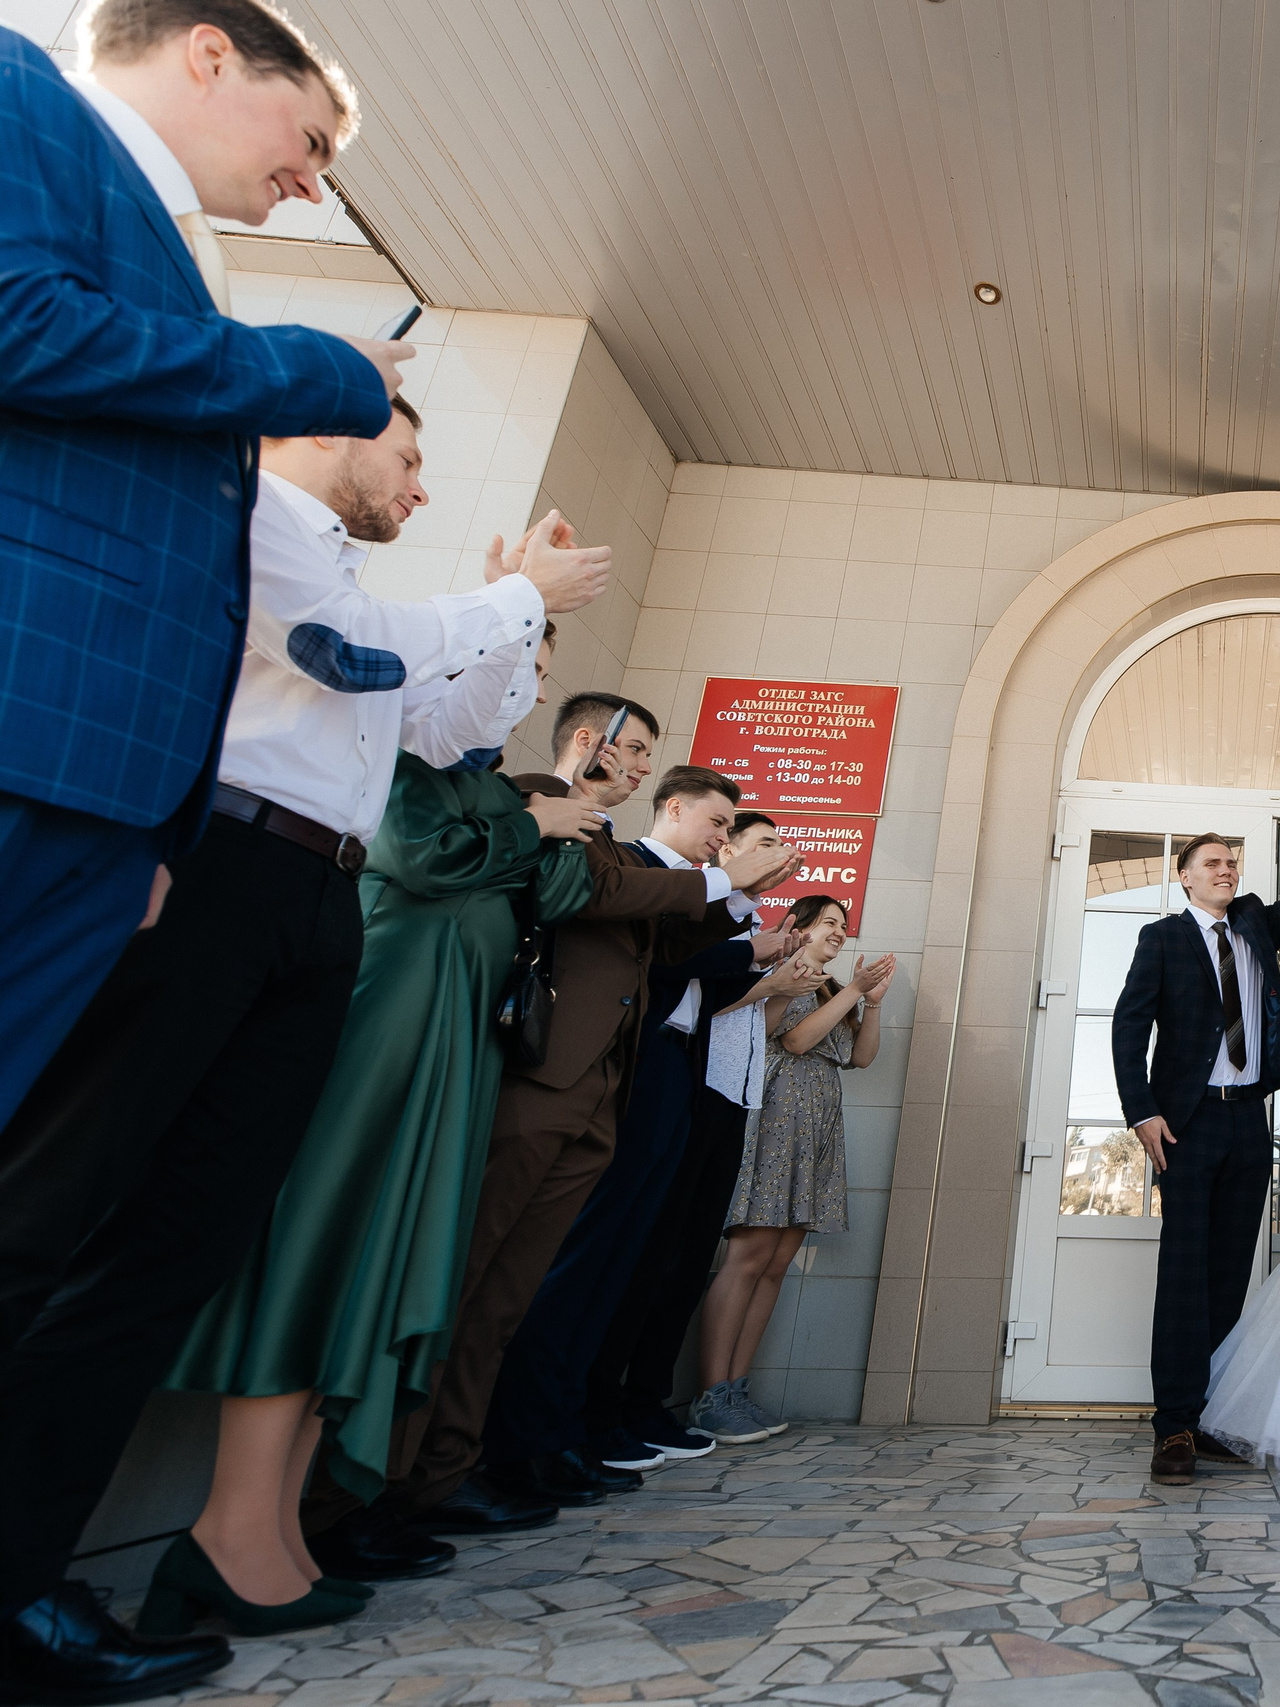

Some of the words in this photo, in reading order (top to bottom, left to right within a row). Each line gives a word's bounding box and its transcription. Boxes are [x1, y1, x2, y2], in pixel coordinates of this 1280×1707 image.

[758, 688, 806, 700] ОТДЕЛ
[809, 690, 844, 702] ЗАГС
[730, 699, 866, 715] АДМИНИСТРАЦИИ
[716, 711, 813, 725] СОВЕТСКОГО
[816, 714, 876, 728] РАЙОНА
[754, 725, 847, 740] ВОЛГОГРАДА
[753, 744, 786, 754] Режим
[787, 747, 827, 756] работы:
[711, 758, 726, 766] ПН
[734, 759, 749, 767] СБ
[777, 758, 812, 770] 08-30
[829, 761, 864, 773] 17-30
[775, 772, 810, 783] 13-00
[811, 777, 825, 785] до
[827, 774, 861, 786] 14-00
[779, 795, 842, 804] воскресенье
[795, 840, 862, 855] ПЯТНИЦУ
[795, 866, 857, 884] ЗАГС
